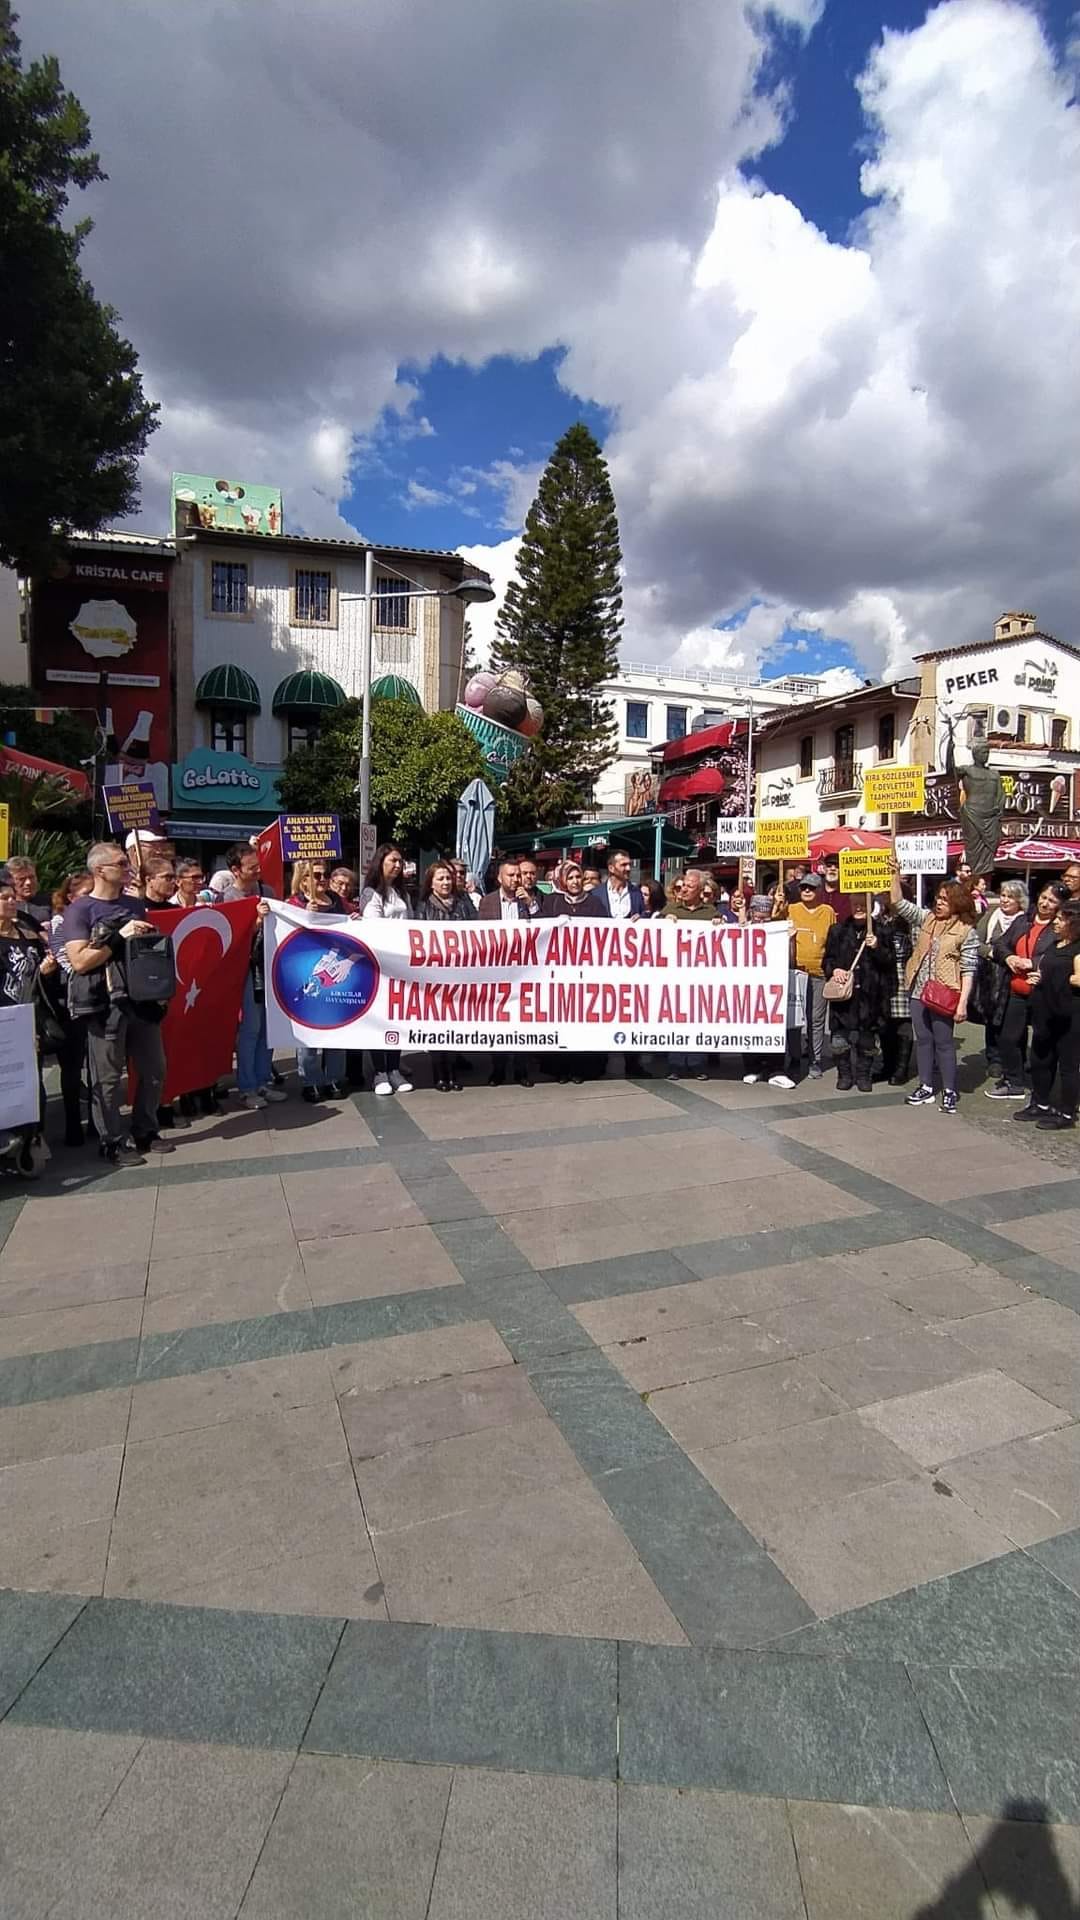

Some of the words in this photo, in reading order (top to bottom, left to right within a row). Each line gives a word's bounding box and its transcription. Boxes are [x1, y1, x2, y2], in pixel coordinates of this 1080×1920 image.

[76, 564, 128, 580] KRİSTAL
[131, 570, 164, 582] CAFE
[945, 668, 999, 694] PEKER
[317, 825, 327, 833] VE
[721, 821, 733, 833] HAK
[760, 834, 784, 844] TOPRAK
[408, 928, 540, 967] BARINMAK
[545, 926, 668, 967] ANAYASAL
[676, 928, 767, 967] HAKTIR
[388, 978, 512, 1022] HAKKIMIZ
[519, 970, 649, 1024] ELİMİZDEN
[658, 984, 784, 1025] ALINAMAZ
[408, 1029, 567, 1049] kiracilardayanismasi_
[631, 1031, 690, 1046] kiracılar
[695, 1032, 785, 1050] dayanışması
